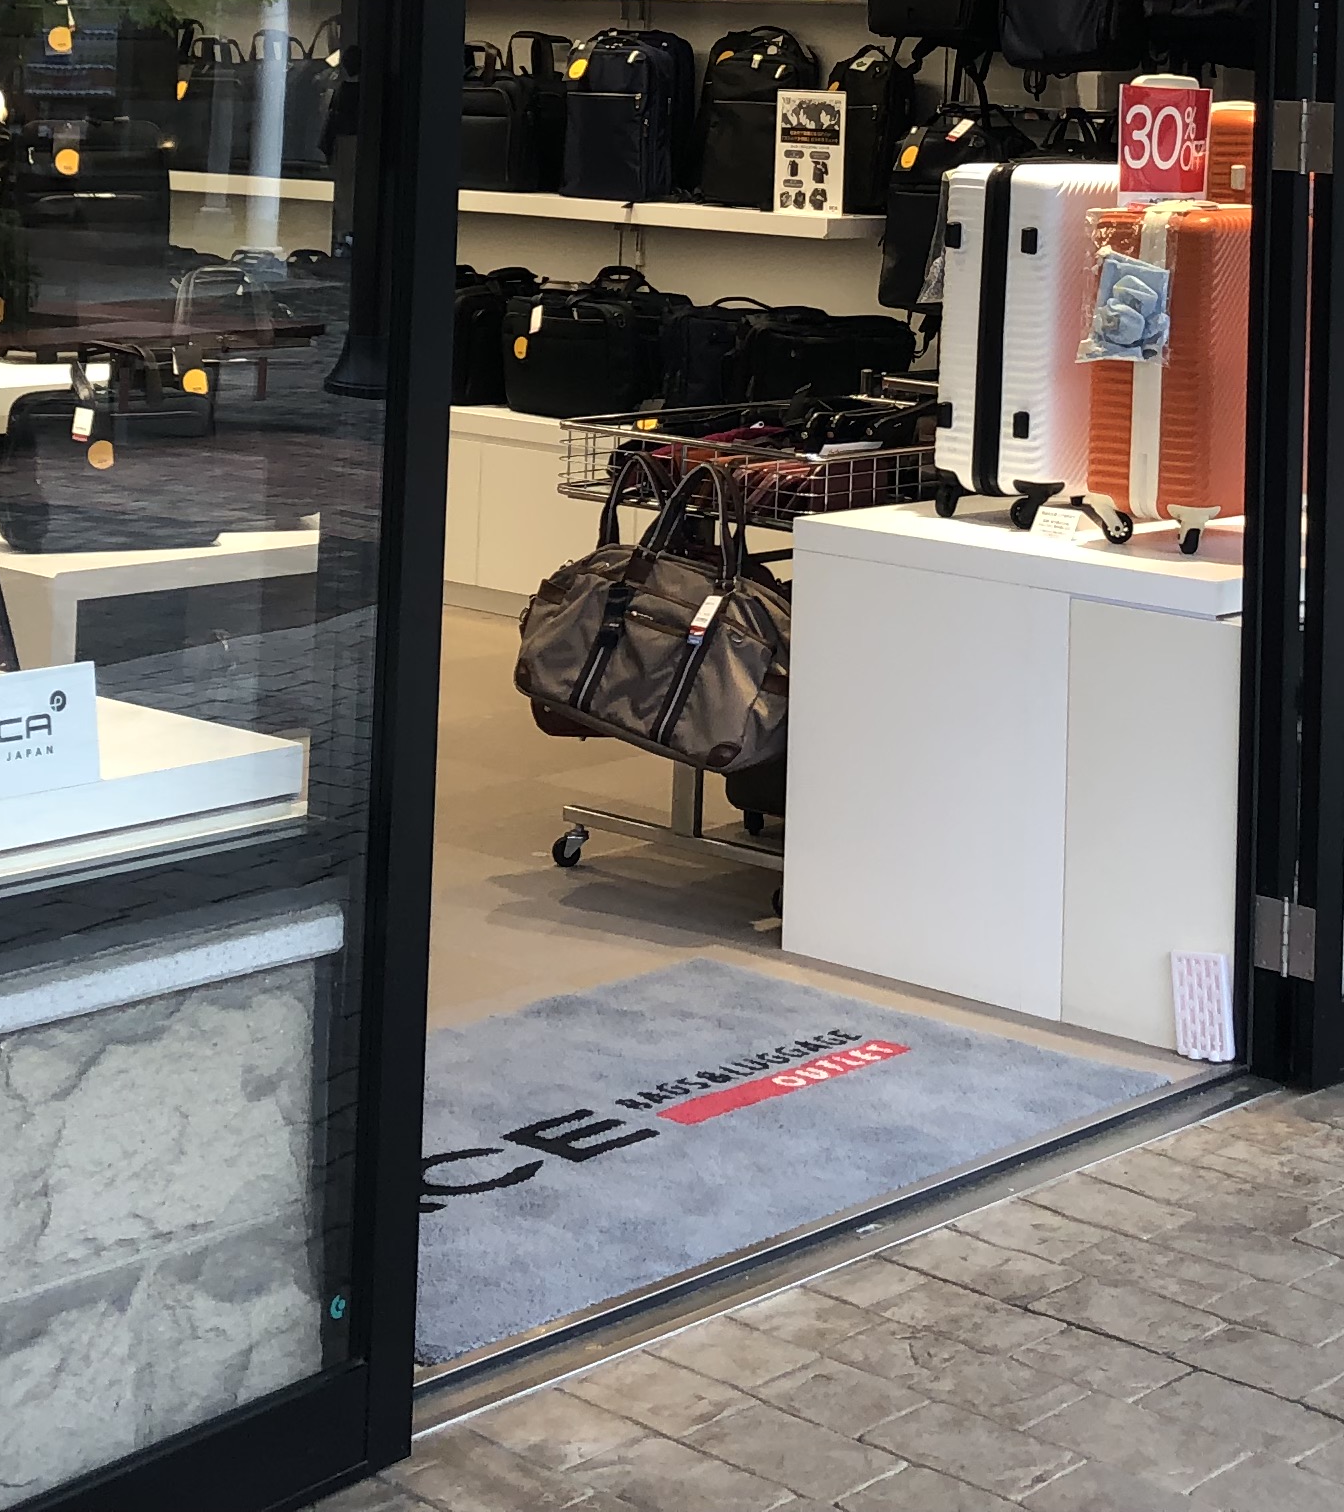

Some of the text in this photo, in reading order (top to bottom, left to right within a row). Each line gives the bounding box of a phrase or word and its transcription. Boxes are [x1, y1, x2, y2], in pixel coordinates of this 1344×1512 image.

[1124, 104, 1197, 170] 30%
[6, 745, 55, 762] JAPAN
[772, 1044, 894, 1087] OUTLET
[419, 1109, 661, 1213] CE
